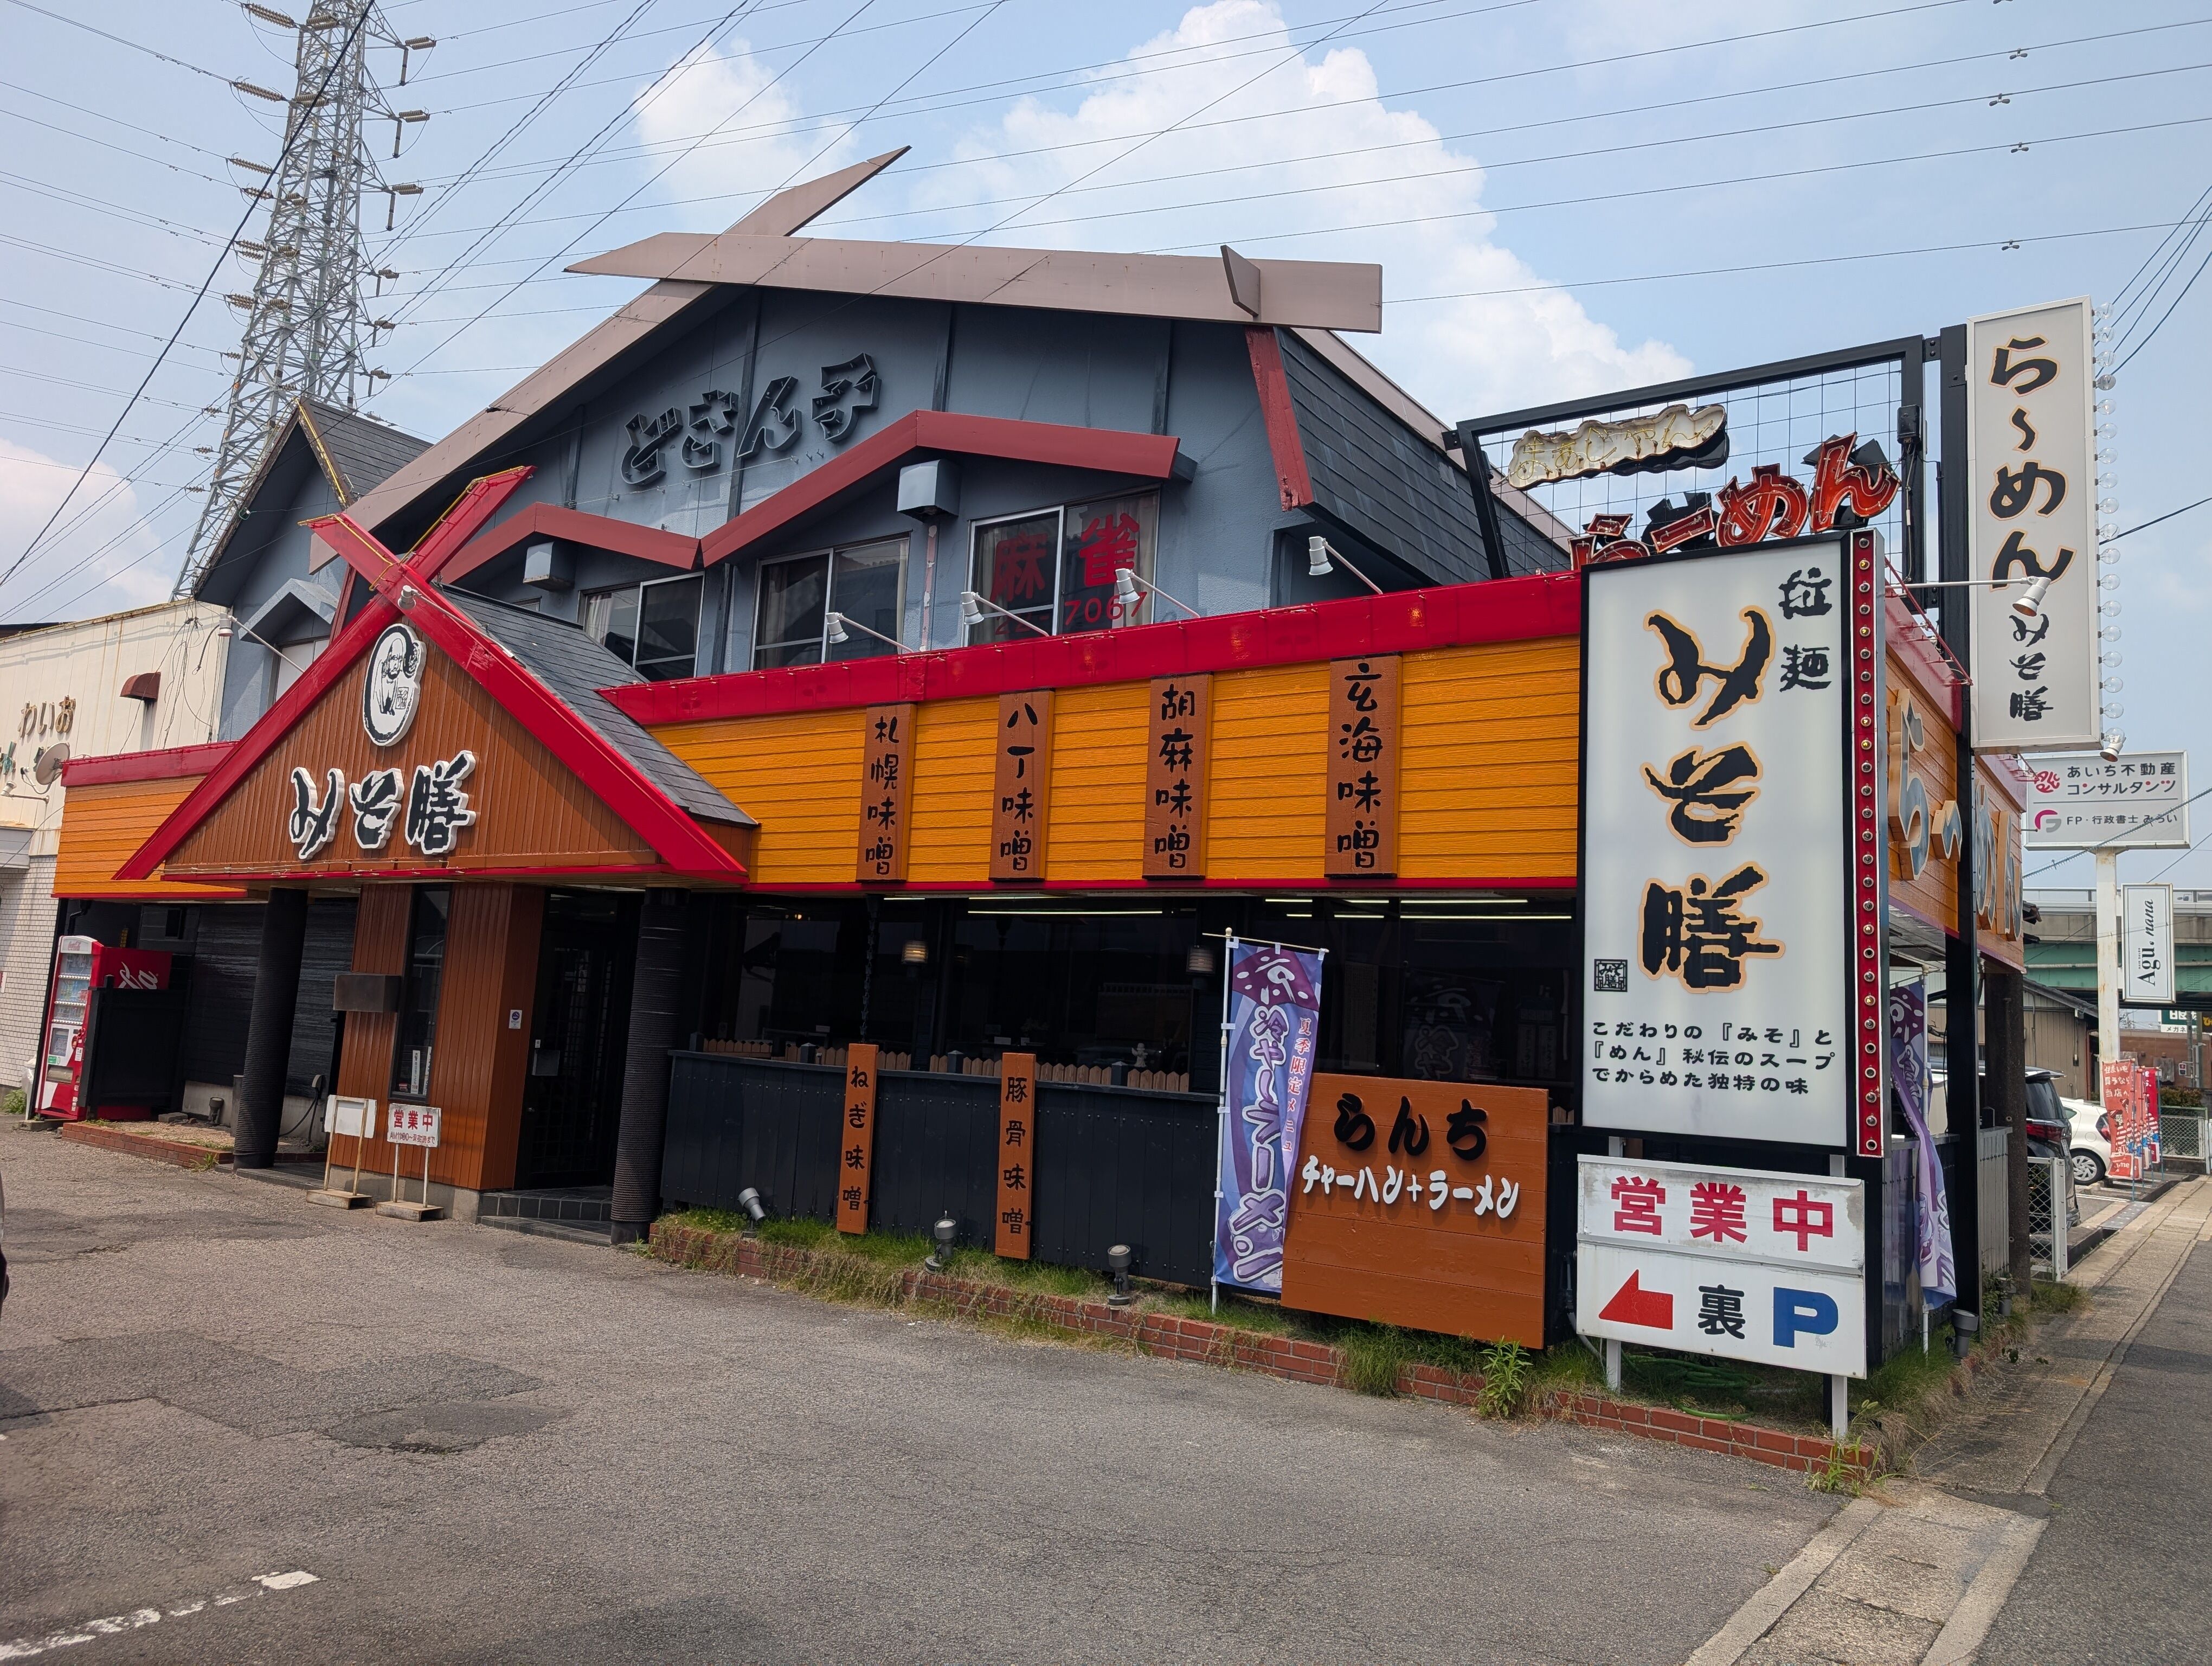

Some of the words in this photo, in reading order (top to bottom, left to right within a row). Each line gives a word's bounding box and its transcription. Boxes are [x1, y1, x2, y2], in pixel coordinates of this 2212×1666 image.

[621, 351, 881, 485] どさん子
[990, 512, 1140, 603] 麻雀
[2009, 613, 2054, 722] みそ膳
[289, 750, 476, 860] みそ膳
[866, 716, 900, 875] 札幌味噌
[1000, 703, 1038, 871] 八丁味噌
[1154, 683, 1195, 868] 胡麻味噌
[1337, 662, 1383, 868] 玄海味噌
[1638, 606, 1785, 994] みそ膳
[2067, 762, 2176, 778] あいち不動産
[2067, 780, 2176, 795] コンサルタンツ
[2144, 899, 2154, 936] nana
[1592, 1022, 1832, 1048] こだわりの『みそ』と
[1594, 1040, 1836, 1071] 『めん』秘伝のスープ
[394, 1109, 433, 1132] 営業中
[1592, 1067, 1809, 1095] でからめた独特の味
[843, 1066, 869, 1211] ねぎ味噌
[1002, 1077, 1028, 1234] 豚骨味噌
[1334, 1093, 1488, 1161] らんち
[1611, 1176, 1834, 1252] 営業中
[1697, 1284, 1746, 1340] 裏
[1773, 1286, 1839, 1349] P
